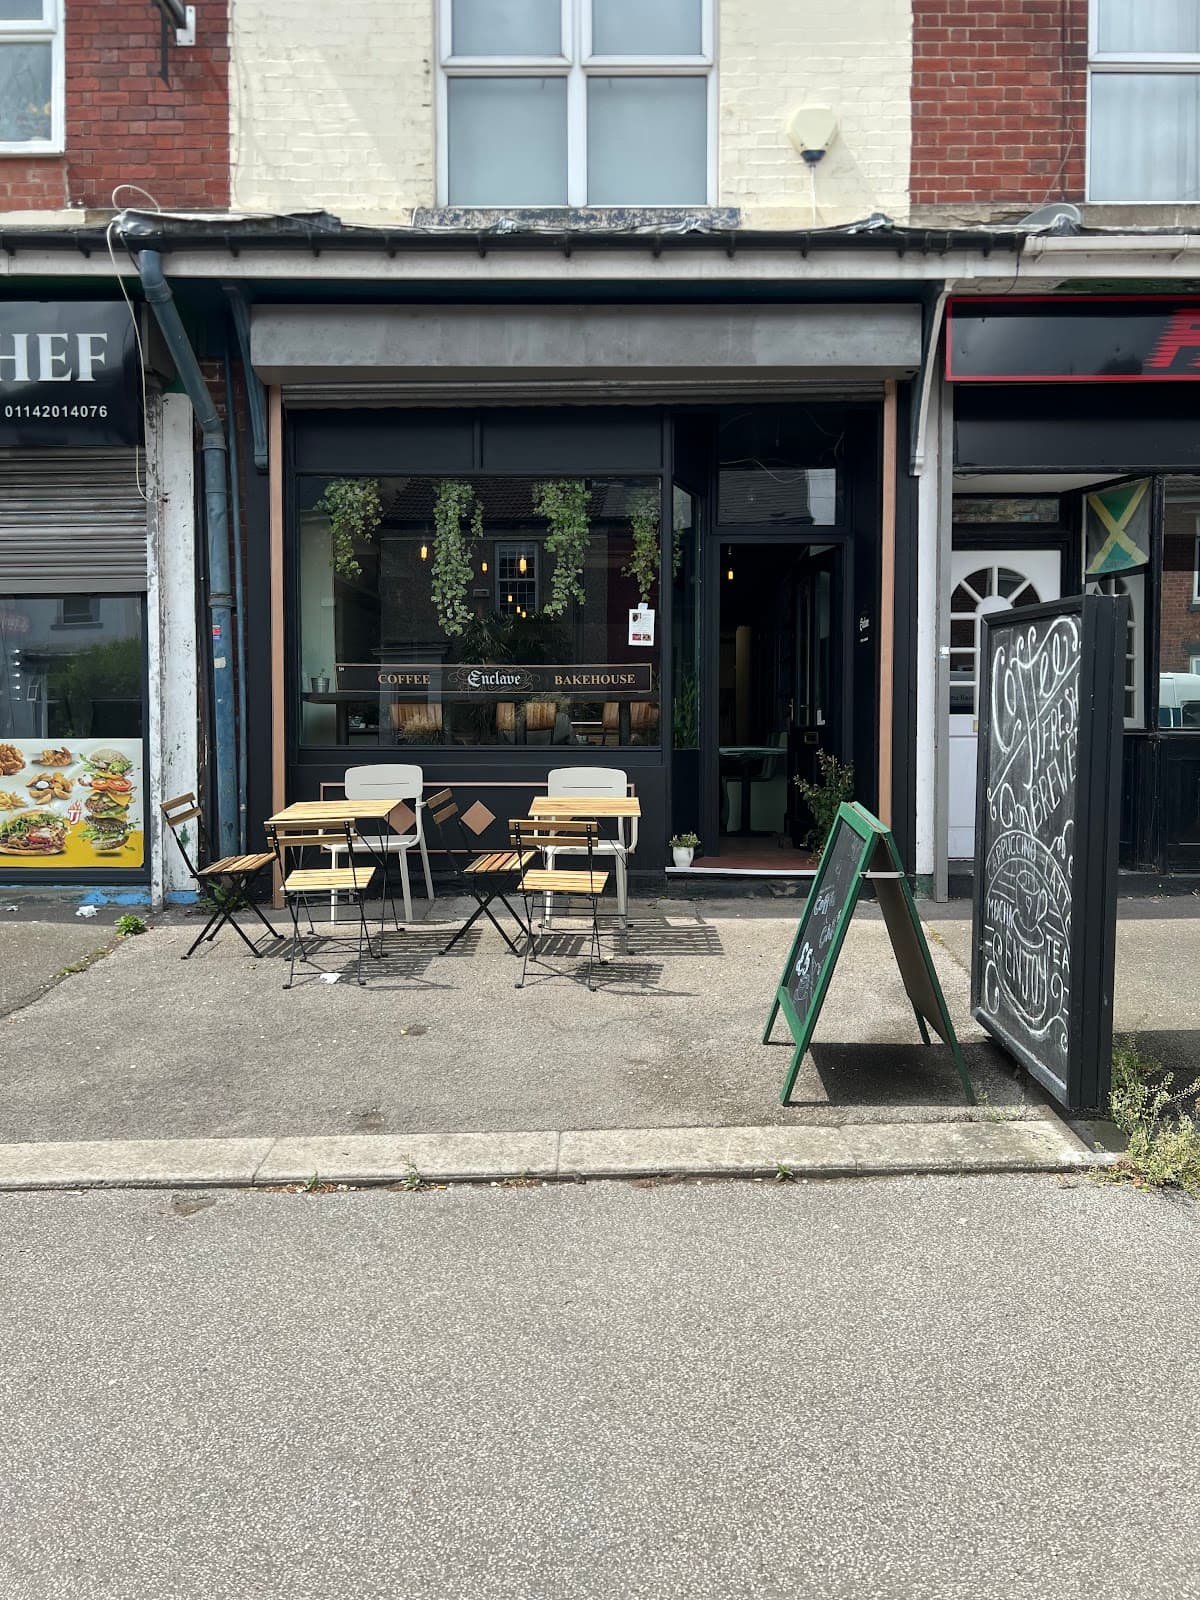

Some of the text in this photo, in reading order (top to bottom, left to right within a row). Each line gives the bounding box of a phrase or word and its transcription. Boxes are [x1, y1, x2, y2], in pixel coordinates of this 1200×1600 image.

[0, 333, 108, 382] HEF
[4, 405, 108, 418] 01142014076
[377, 670, 636, 688] COFFEE Enclave BAKEHOUSE
[1030, 727, 1078, 833] BREWE
[987, 835, 1037, 880] CAPPUCCINO
[796, 941, 814, 977] £5
[1005, 932, 1048, 1010] ENJOY
[1046, 934, 1070, 973] TEA
